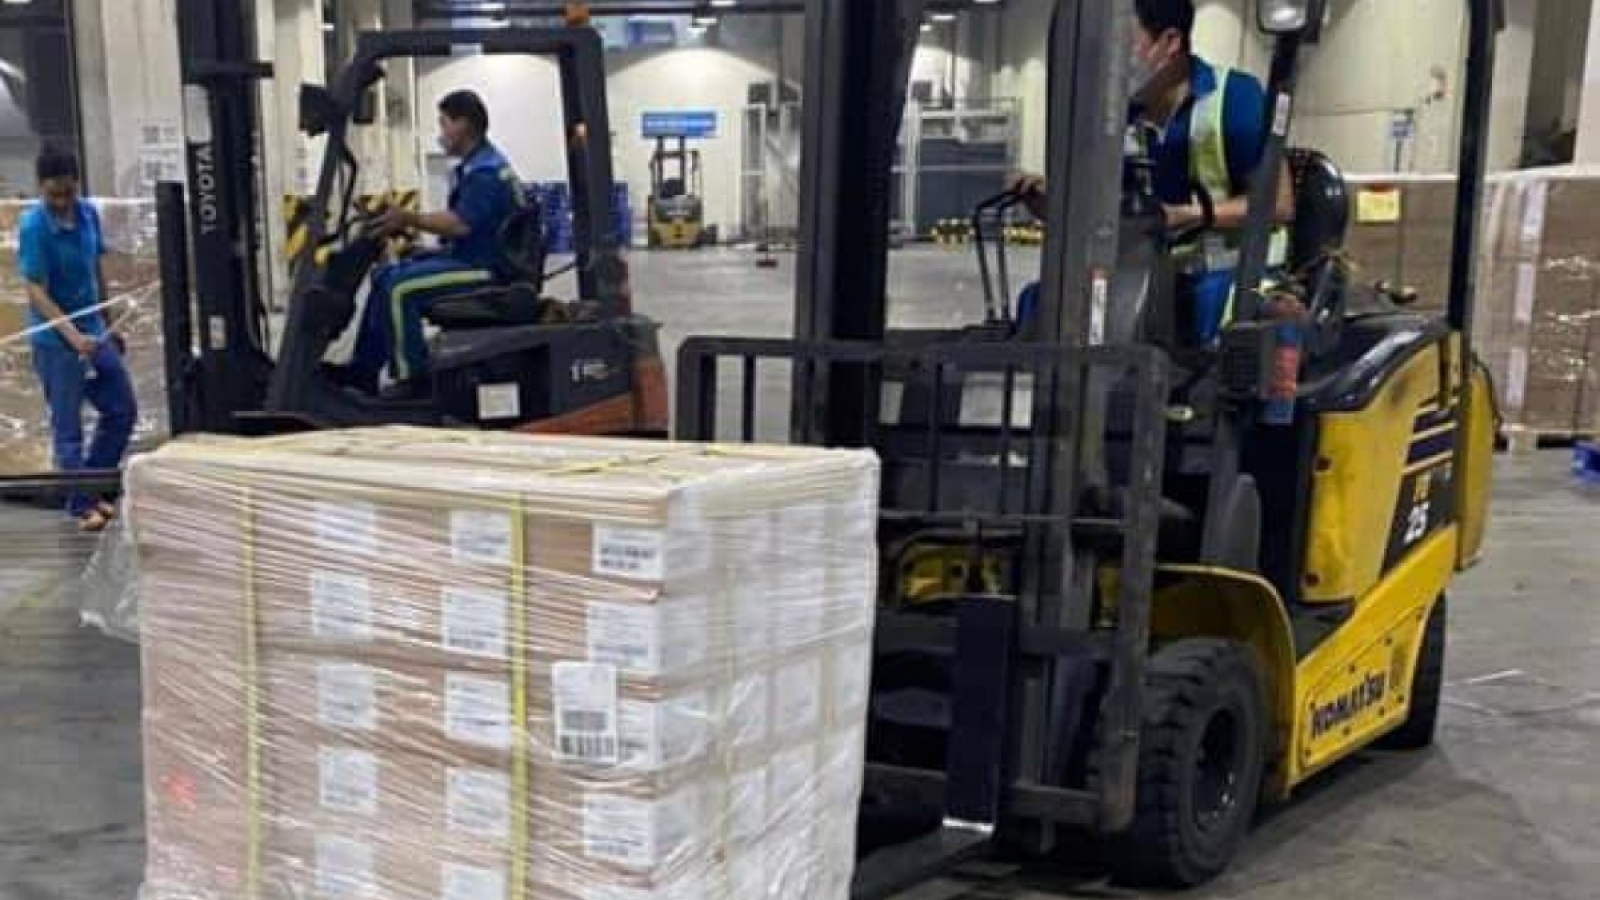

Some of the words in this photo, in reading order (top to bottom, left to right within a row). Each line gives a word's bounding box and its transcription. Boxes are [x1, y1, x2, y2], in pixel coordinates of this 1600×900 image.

[197, 144, 216, 235] TOYOTA
[1404, 502, 1430, 544] 25
[1311, 671, 1385, 739] KOMATSU
